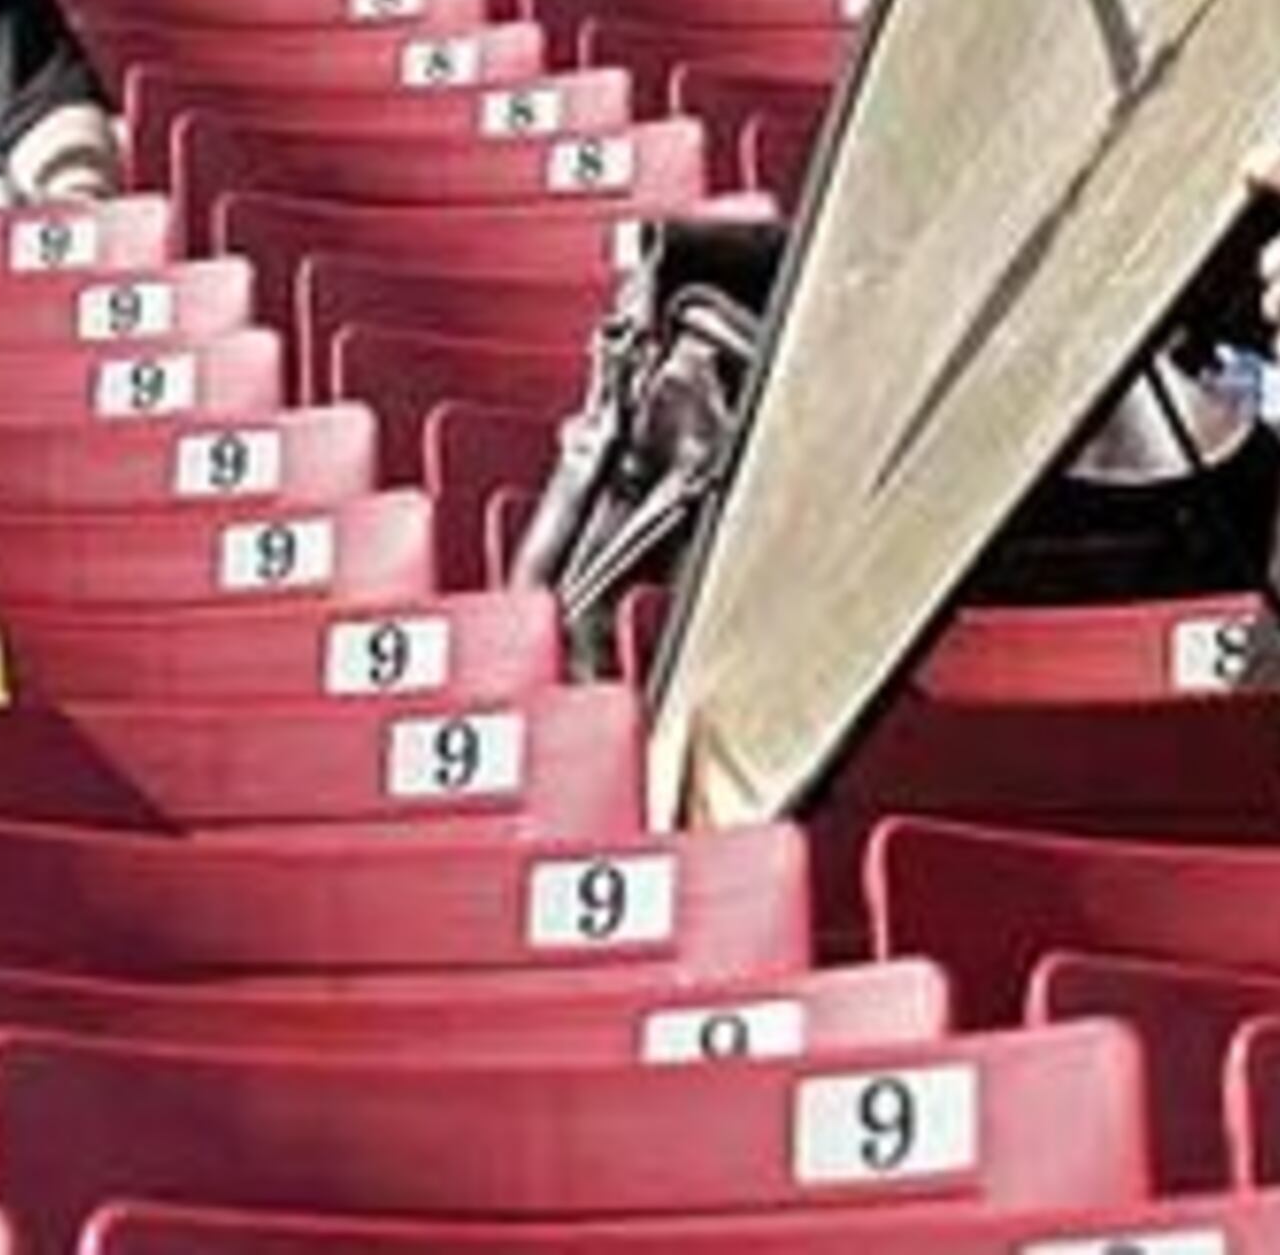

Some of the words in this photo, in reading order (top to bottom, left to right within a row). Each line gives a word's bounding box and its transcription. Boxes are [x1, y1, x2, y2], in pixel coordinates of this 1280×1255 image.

[505, 94, 537, 130] 8
[573, 147, 606, 184] 8
[38, 225, 72, 263] 9
[109, 290, 142, 332] 9
[130, 366, 166, 408] 9
[209, 437, 248, 488] 9
[258, 527, 297, 582] 9
[366, 624, 410, 685] 9
[434, 722, 480, 790] 9
[577, 864, 626, 940] 9
[858, 1079, 916, 1170] 9
